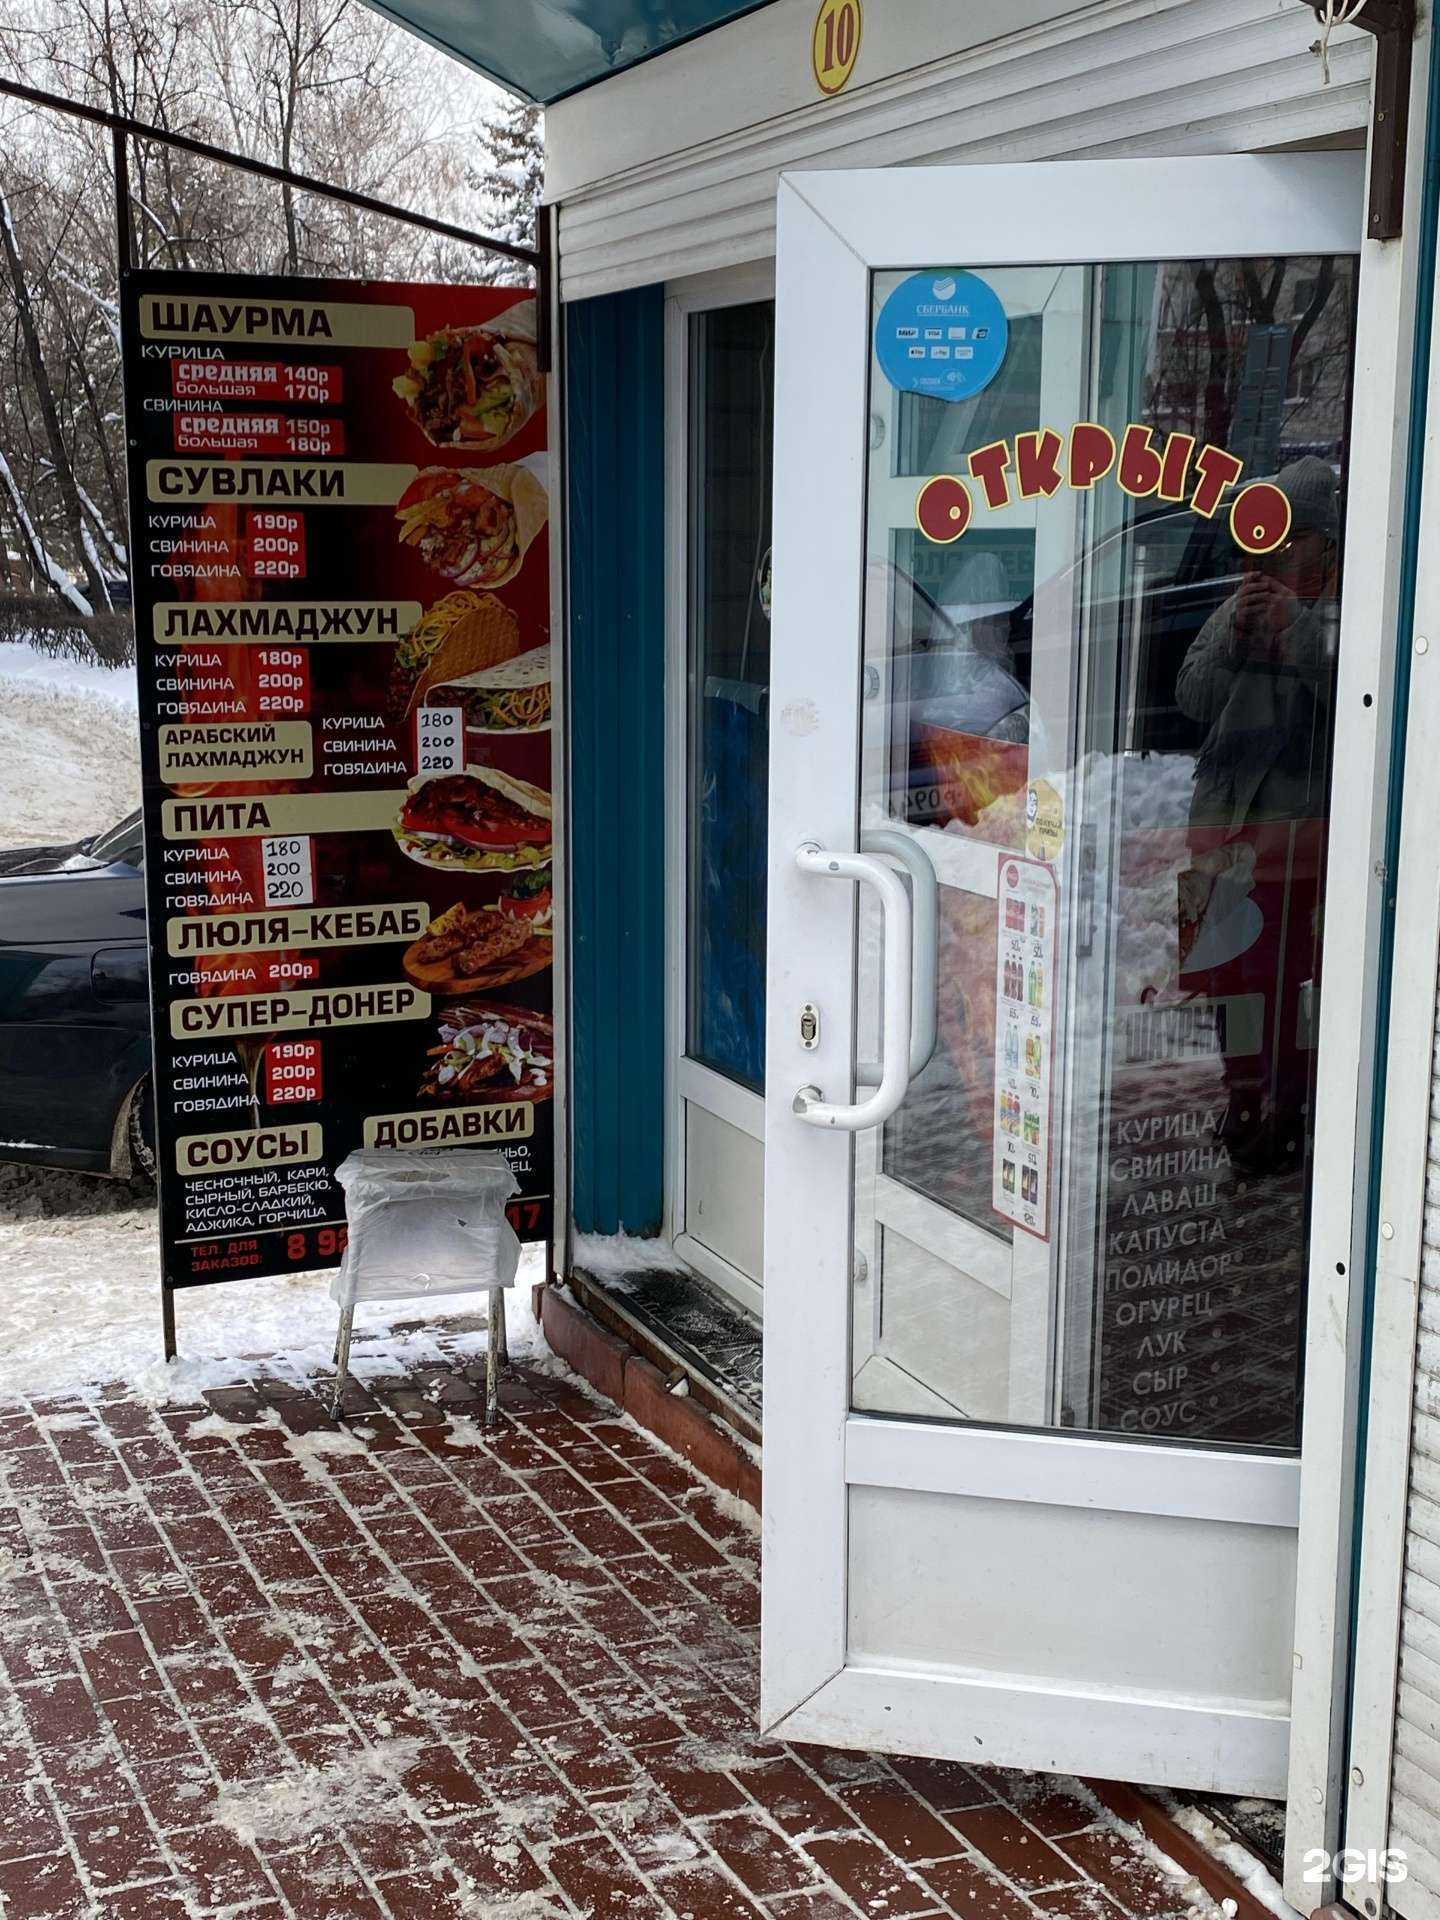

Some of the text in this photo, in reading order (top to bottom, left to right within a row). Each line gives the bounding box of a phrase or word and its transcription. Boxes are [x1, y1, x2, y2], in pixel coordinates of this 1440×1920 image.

[823, 3, 854, 73] 10
[151, 301, 333, 338] ШАУРМА
[916, 304, 969, 314] СБЕРБАНК
[142, 345, 224, 360] КУРИЦА
[178, 364, 329, 386] средняя 140р
[176, 381, 329, 403] большая 170р
[143, 398, 223, 413] СВИНИНА
[180, 416, 330, 438] средняя 150р
[178, 435, 331, 455] большая 180р
[158, 467, 344, 498] СУВЛАКИ
[916, 422, 1291, 554] ОТКРЫТО
[148, 514, 298, 532] КУРИЦА 190р
[150, 538, 298, 555] СВИНИНА 200р
[151, 561, 299, 578] ГОВЯДИНА 220р
[164, 608, 398, 640] ЛАХМАДЖУН
[155, 651, 302, 668] КУРИЦА 180р
[156, 674, 303, 692] СВИНИНА 200р
[157, 696, 304, 716] ГОВЯДИНА 220р
[322, 714, 453, 730] КУРИЦА 180
[165, 723, 276, 746] АРАБСКИЙ
[323, 735, 454, 753] СВИНИНА 200
[166, 748, 304, 768] ЛАХМАДЖУН
[324, 756, 454, 776] ГОВЯДИНА 220
[174, 802, 271, 832] ПИТА
[164, 841, 300, 862] КУРИЦА 180
[165, 862, 300, 886] СВИНИНА 200
[166, 882, 304, 908] ГОВЯДИНА 220
[178, 909, 422, 950] ЛЮЛЯ-КЕБАБ
[168, 964, 313, 985] ГОВЯДИНА 200р
[182, 988, 416, 1032] СУПЕР-ДОНЕР
[172, 1044, 314, 1068] КУРИЦА 190р
[173, 1066, 316, 1090] СВИНИНА 200р
[174, 1086, 316, 1114] ГОВЯДИНА 220р
[374, 1108, 526, 1148] ДОБАВКИ
[187, 1130, 308, 1167] СОУСЫ
[1110, 1145, 1232, 1182] СВИНИНА
[185, 1166, 330, 1192] ЧЕСНОЧНЫЙ, КАРИ,
[258, 1180, 332, 1197] БАРБЕКЮ,
[1121, 1183, 1218, 1218] ЛАВАШ
[186, 1207, 327, 1233] АДЖИКА, ГОРЧИЦА
[228, 1239, 258, 1254] ДЛЯ
[287, 1233, 306, 1260] 8
[1109, 1218, 1226, 1255] КАПУСТА
[1105, 1254, 1232, 1291] ПОМИДОР
[1116, 1291, 1212, 1326] ОГУРЕЦ
[1137, 1330, 1188, 1360] ЛУК
[1132, 1366, 1189, 1394] СЫР
[1120, 1400, 1198, 1432] СОУС
